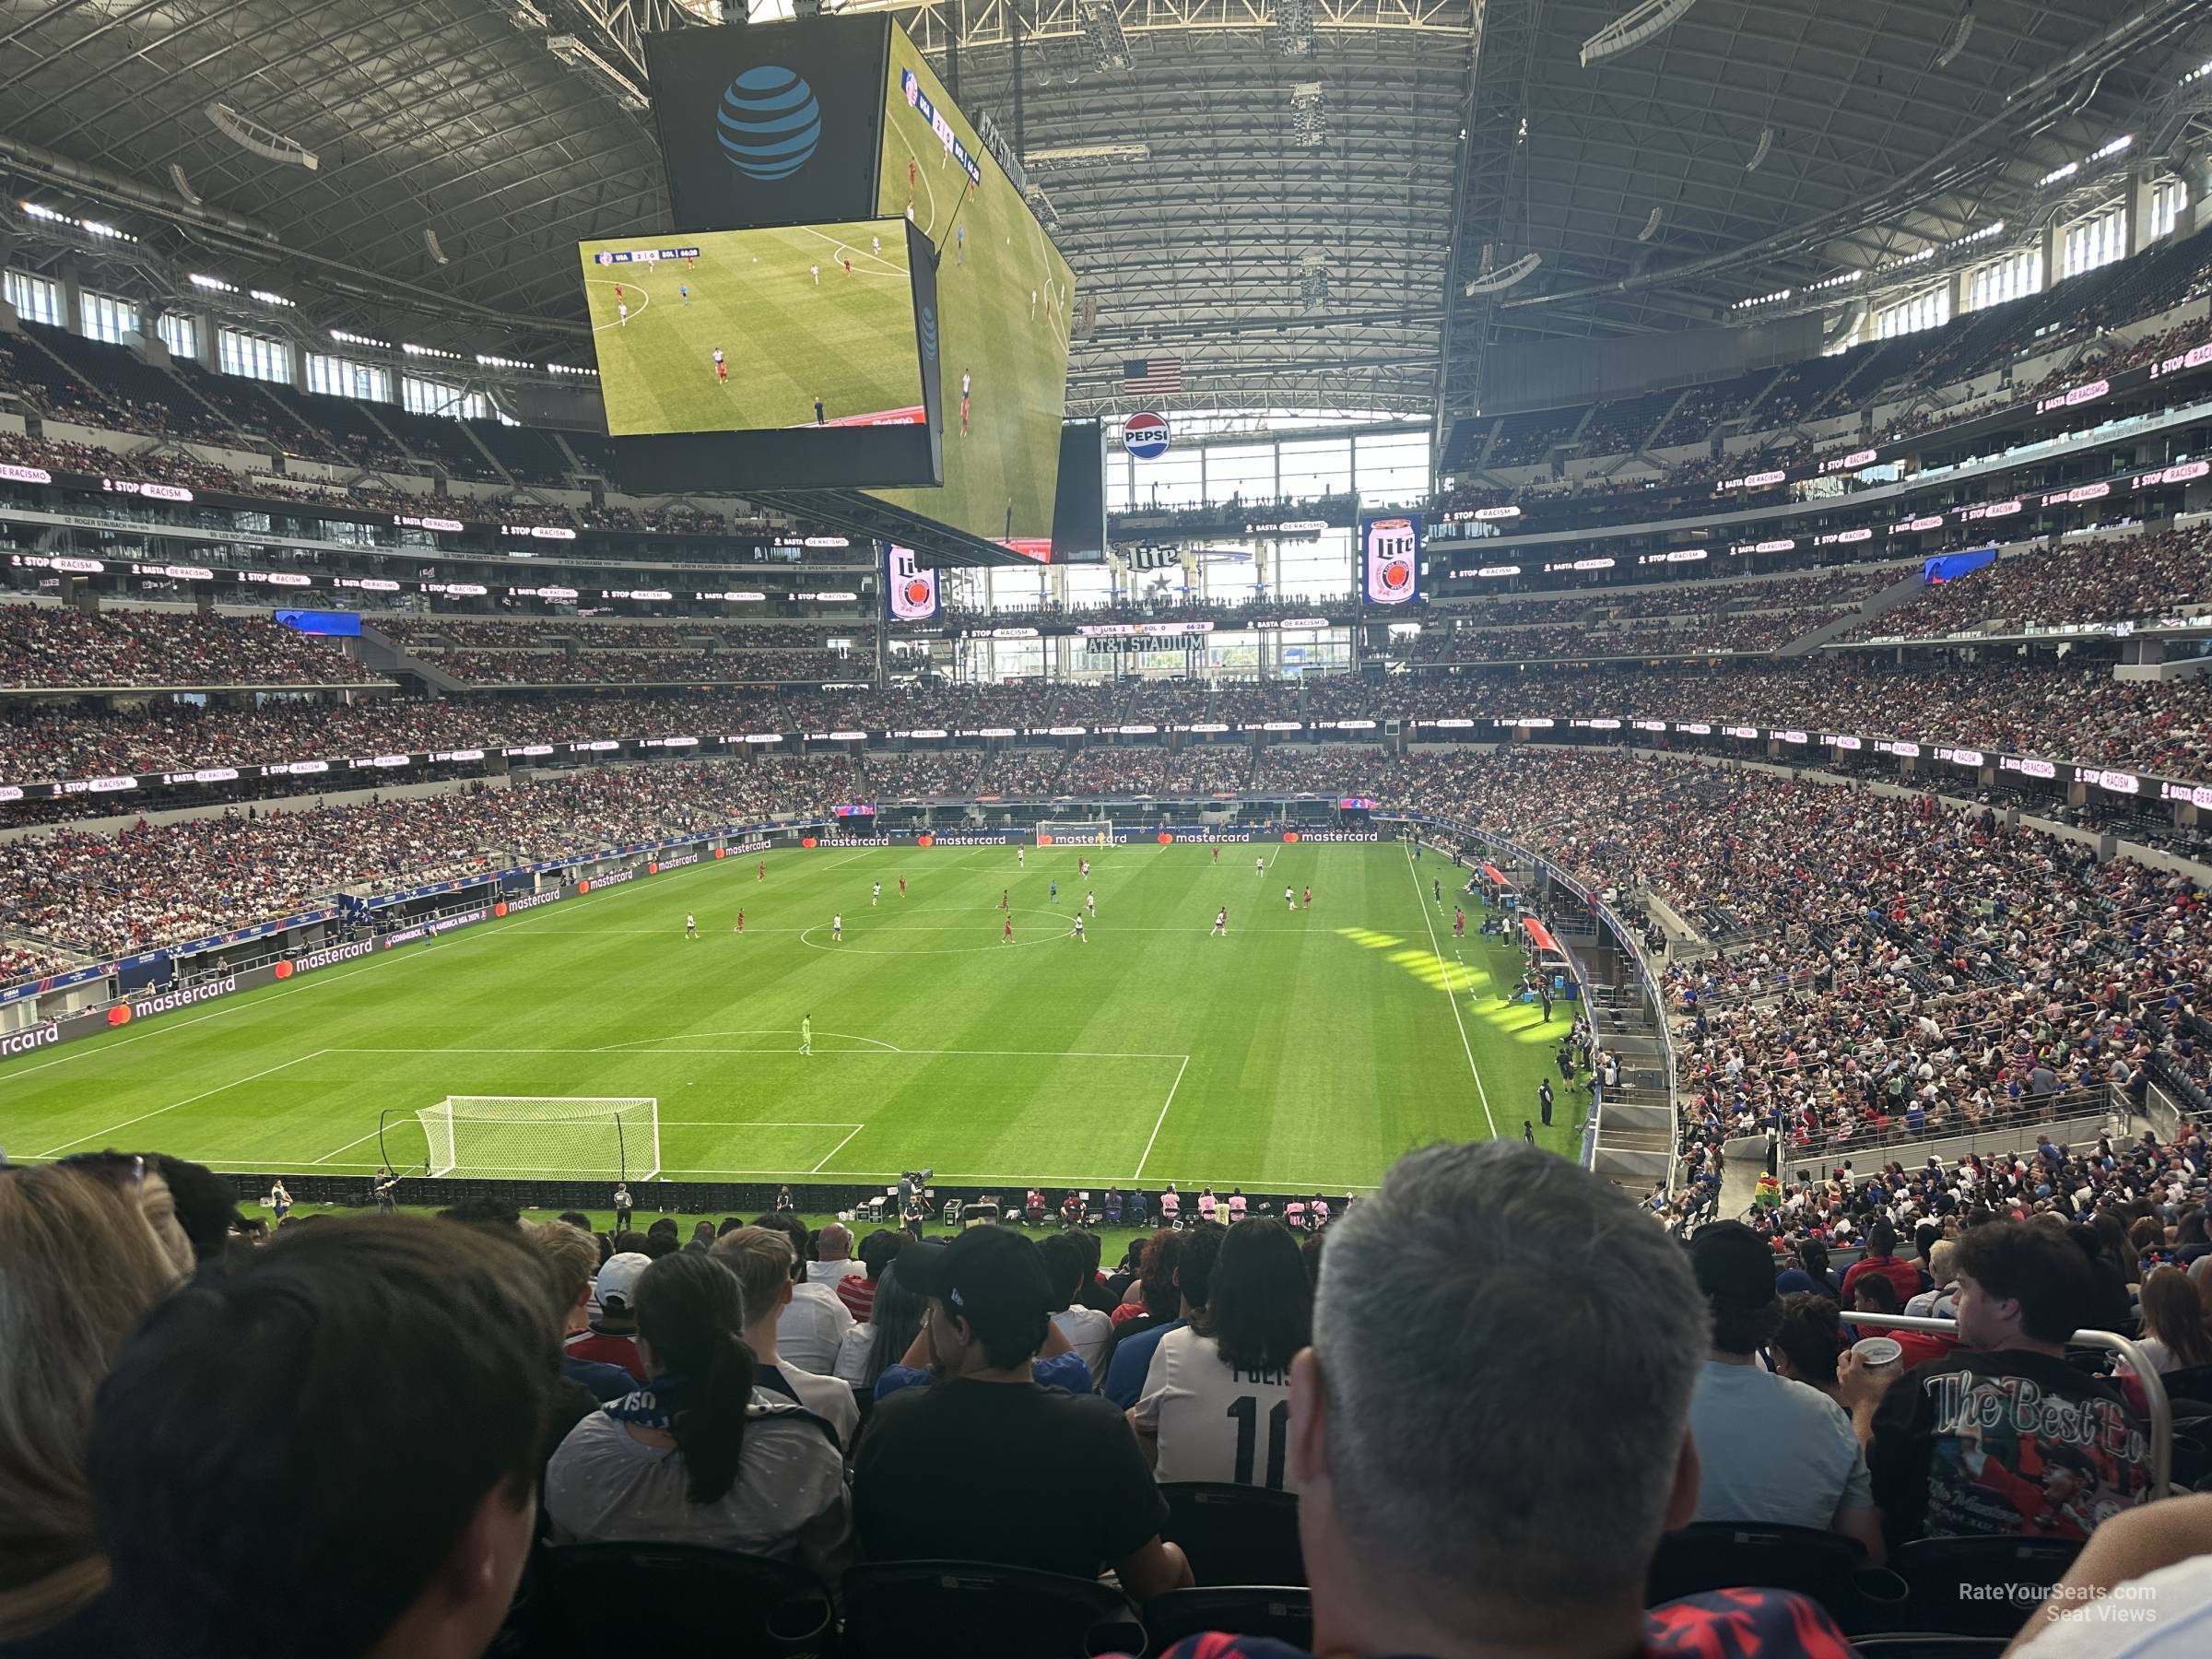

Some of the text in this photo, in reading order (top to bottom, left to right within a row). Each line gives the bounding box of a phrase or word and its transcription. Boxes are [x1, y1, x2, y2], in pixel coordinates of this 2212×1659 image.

[920, 96, 931, 118] USA
[936, 119, 941, 131] 2
[946, 133, 950, 144] 0
[955, 142, 965, 161] BOL
[980, 112, 1027, 194] AT&T STADIUM
[2161, 355, 2183, 373] STOP
[2070, 391, 2078, 401] DE
[2078, 384, 2105, 399] RACISMO
[1125, 430, 1168, 441] PEPSI
[1827, 453, 1869, 471] STOP RACISM
[9, 468, 45, 479] RACISMO
[1725, 479, 1744, 488] BASTA
[1759, 473, 1783, 482] RACISMO
[2142, 466, 2198, 487] STOP RACISM
[115, 481, 182, 497] STOP RACISM
[2073, 490, 2080, 499] DE
[2080, 486, 2105, 498] RACISMO
[1969, 504, 2014, 519] STOP RACISM
[74, 518, 95, 526] ROGER
[402, 517, 421, 525] BASTA
[512, 526, 530, 535] STOP
[1822, 531, 1865, 544] STOP RACISM
[1377, 536, 1413, 560] Lite
[1768, 541, 1792, 549] RACISMO
[25, 557, 92, 570] STOP RACISM
[1127, 543, 1179, 573] Lite
[1649, 554, 1666, 562] STOP
[142, 566, 165, 575] BASTA
[182, 569, 210, 578] RACISMO
[248, 573, 267, 582] STOP
[1088, 633, 1205, 653] AT&T STADIUM
[436, 752, 451, 760] STOP
[1939, 749, 1977, 764] STOP RACISM
[208, 769, 235, 779] RACISMO
[270, 762, 320, 774] STOP RACISM
[2024, 761, 2030, 772] DE
[2030, 763, 2052, 775] RACISMO
[66, 778, 126, 793] STOP RACISM
[2083, 771, 2129, 790] STOP RACISM
[819, 835, 888, 847] mastercard
[936, 836, 1006, 845] mastercard
[1176, 833, 1249, 843] mastercard
[1301, 831, 1378, 842] mastercard
[726, 840, 771, 855] mastercard
[659, 853, 697, 871] mastercard
[590, 869, 632, 889] mastercard
[509, 888, 559, 912] mastercard
[392, 928, 421, 944] CONMEBOL
[459, 916, 468, 925] USA
[296, 939, 373, 972] mastercard
[136, 977, 236, 1017] mastercard
[2, 1023, 59, 1055] rcard
[1924, 1371, 2002, 1433] The
[2001, 1376, 2096, 1444] Best
